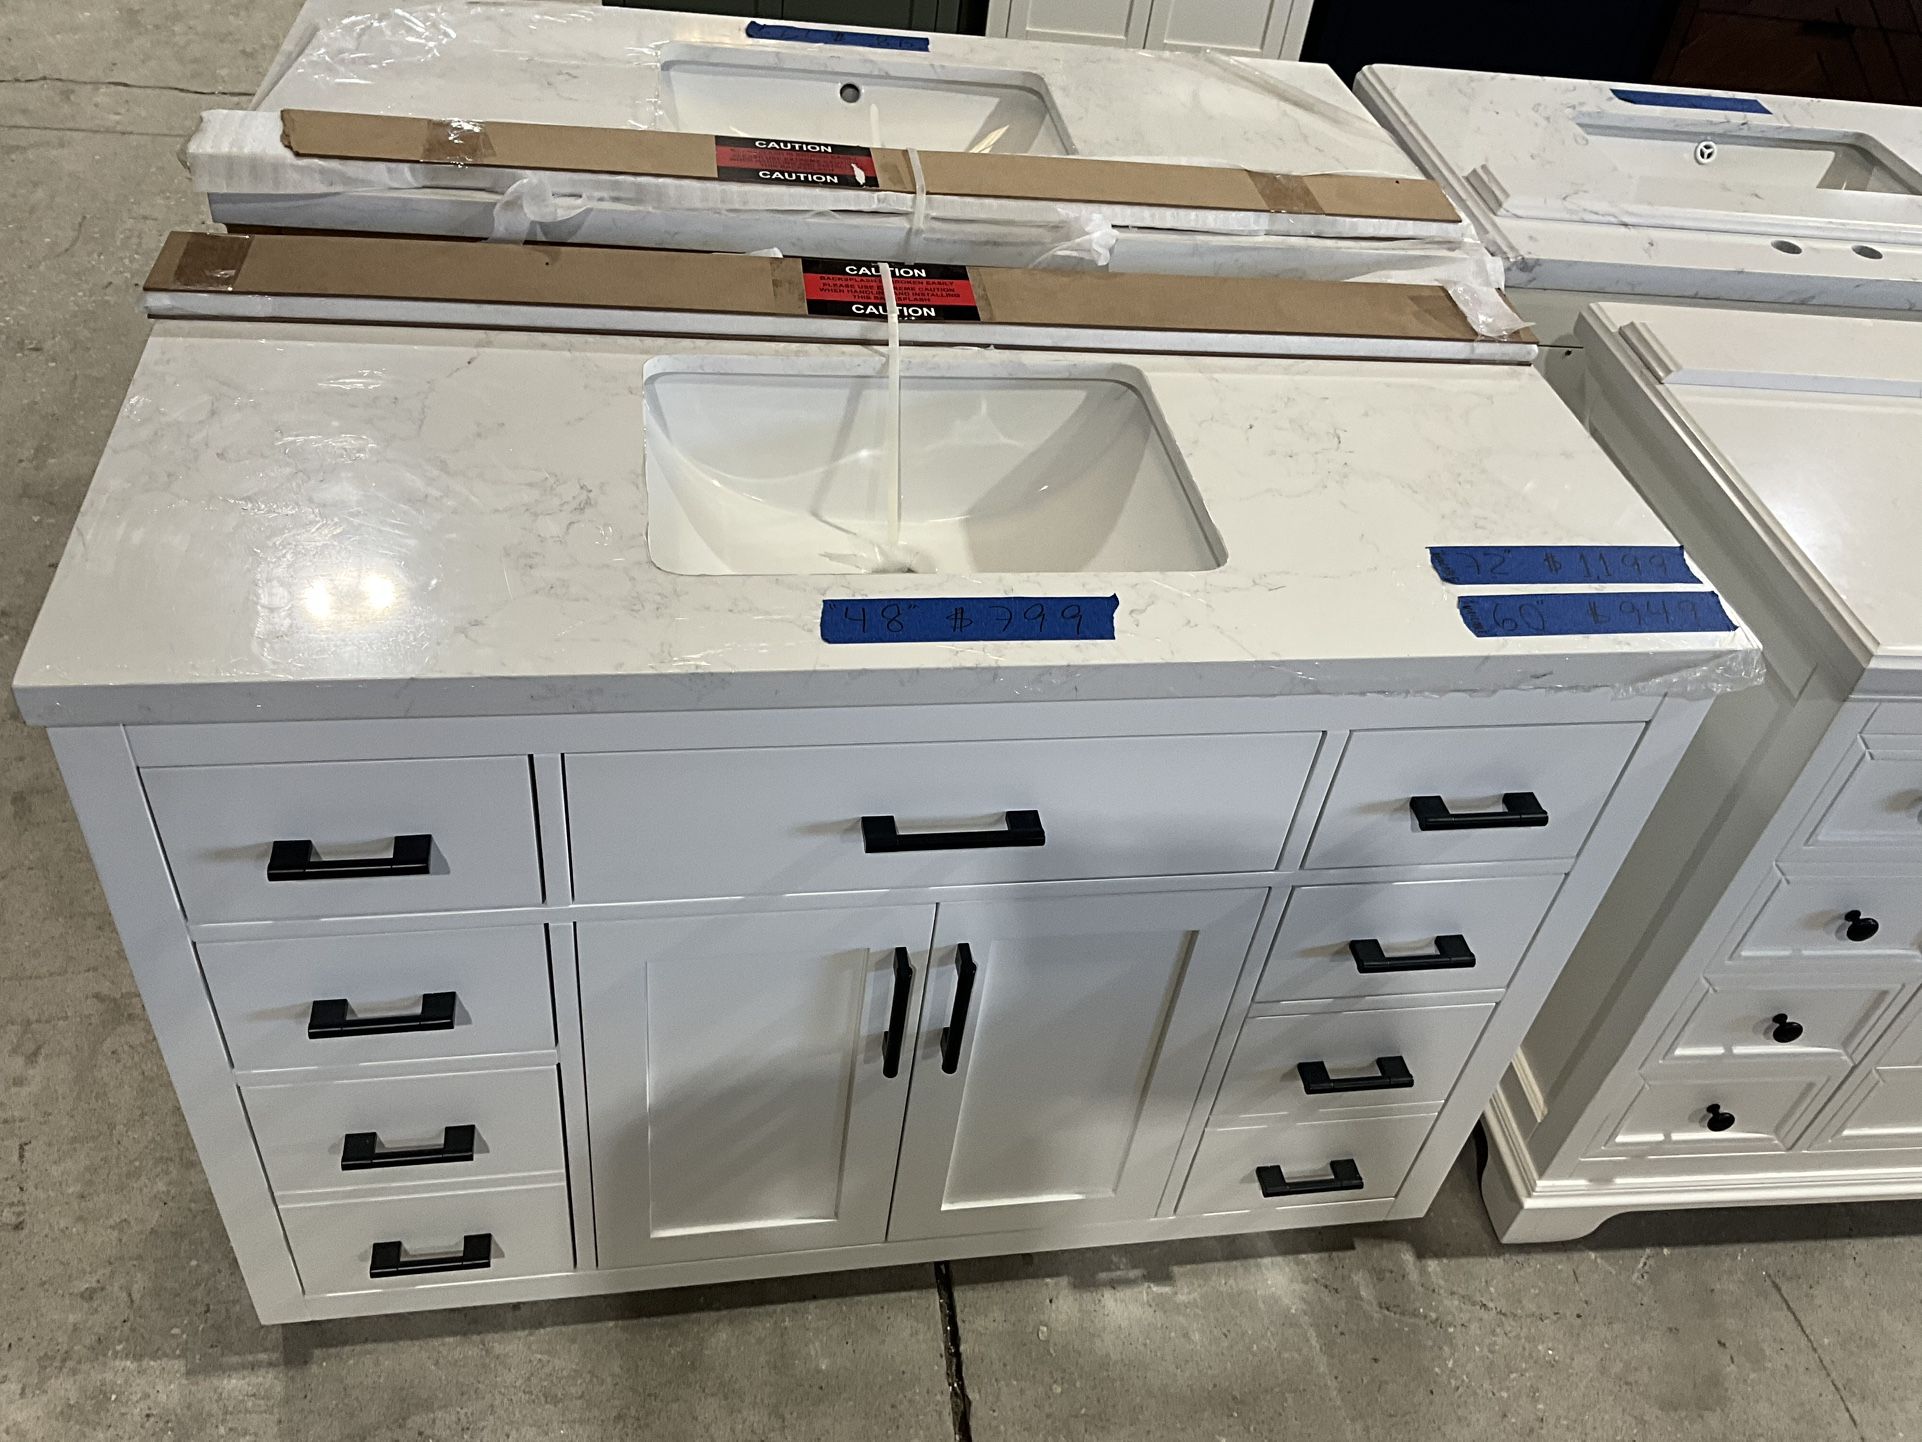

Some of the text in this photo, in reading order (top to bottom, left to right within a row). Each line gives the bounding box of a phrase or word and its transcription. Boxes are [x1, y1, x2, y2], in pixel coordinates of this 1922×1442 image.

[755, 140, 832, 153] CAUTION
[758, 170, 839, 184] CAUTION
[819, 275, 878, 284] BACKSPLASH
[873, 295, 932, 303] BASPLASH
[851, 304, 936, 317] CAUTION
